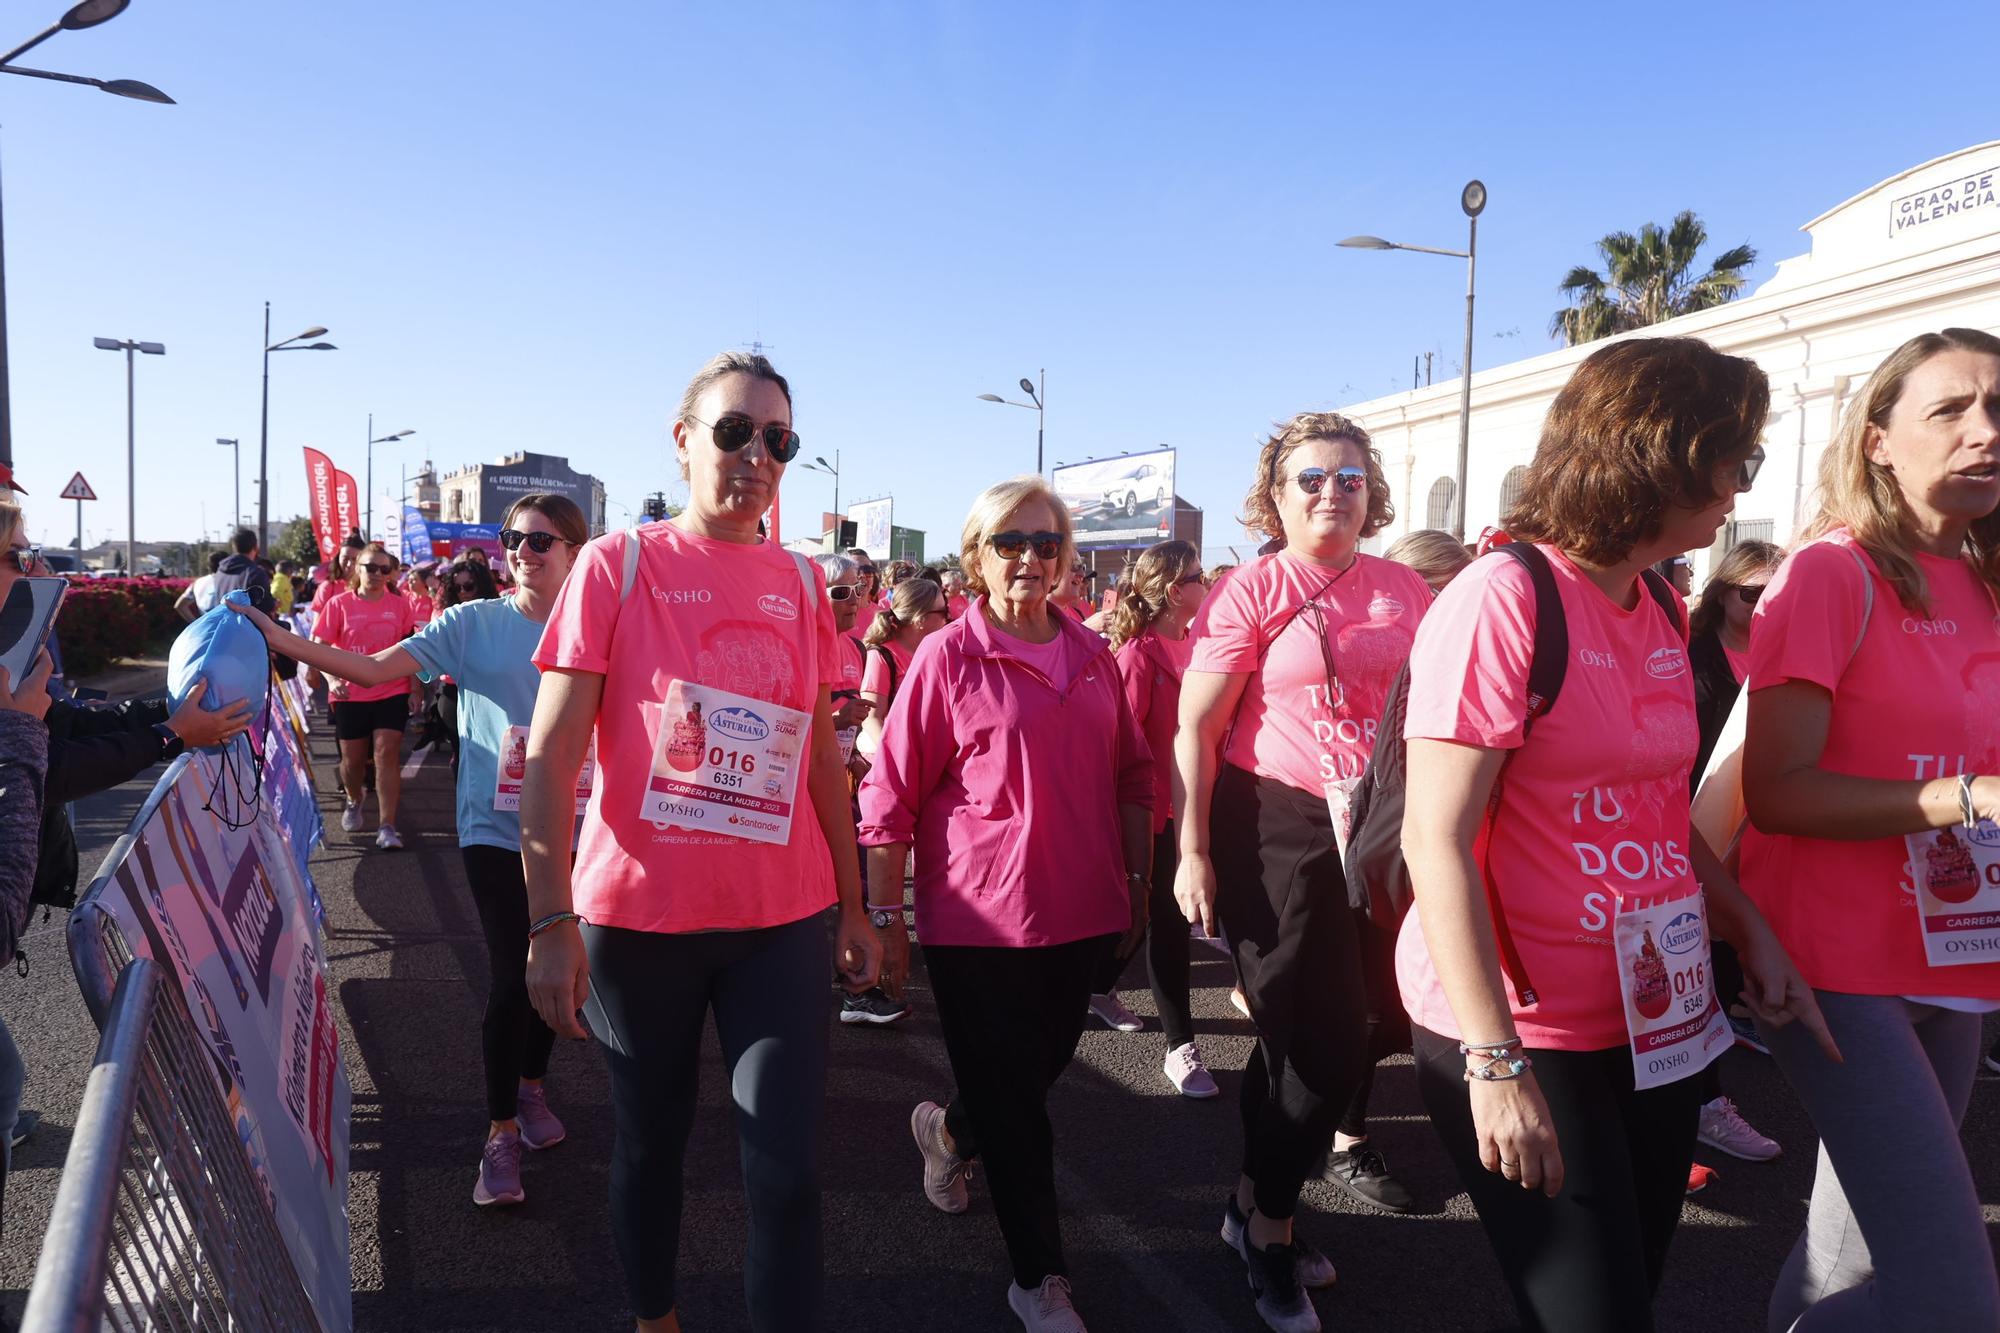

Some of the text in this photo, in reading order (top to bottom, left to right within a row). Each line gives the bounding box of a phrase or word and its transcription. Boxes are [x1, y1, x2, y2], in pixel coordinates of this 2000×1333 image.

[1901, 174, 1993, 213] GRAO DE
[1896, 190, 1995, 230] VALENCIA
[1303, 683, 1346, 709] TU
[712, 714, 766, 738] ASTURIANA
[774, 724, 797, 737] SUMA
[1313, 718, 1378, 744] DOR
[708, 746, 756, 773] 016
[841, 747, 851, 755] 16
[713, 771, 744, 788] 6351
[658, 800, 705, 819] OYSHO
[666, 783, 781, 813] CARRERA DE LA MUJER 2023
[739, 815, 780, 833] Santander
[652, 834, 689, 845] CARRERA
[689, 835, 701, 845] DE
[702, 836, 713, 846] LA
[1572, 840, 1689, 880] DORS
[1673, 961, 1704, 995] 016
[1684, 993, 1704, 1015] 6349
[1649, 1030, 1687, 1046] CARRERA
[1686, 1024, 1696, 1035] DE
[1648, 1050, 1690, 1074] OYSHO
